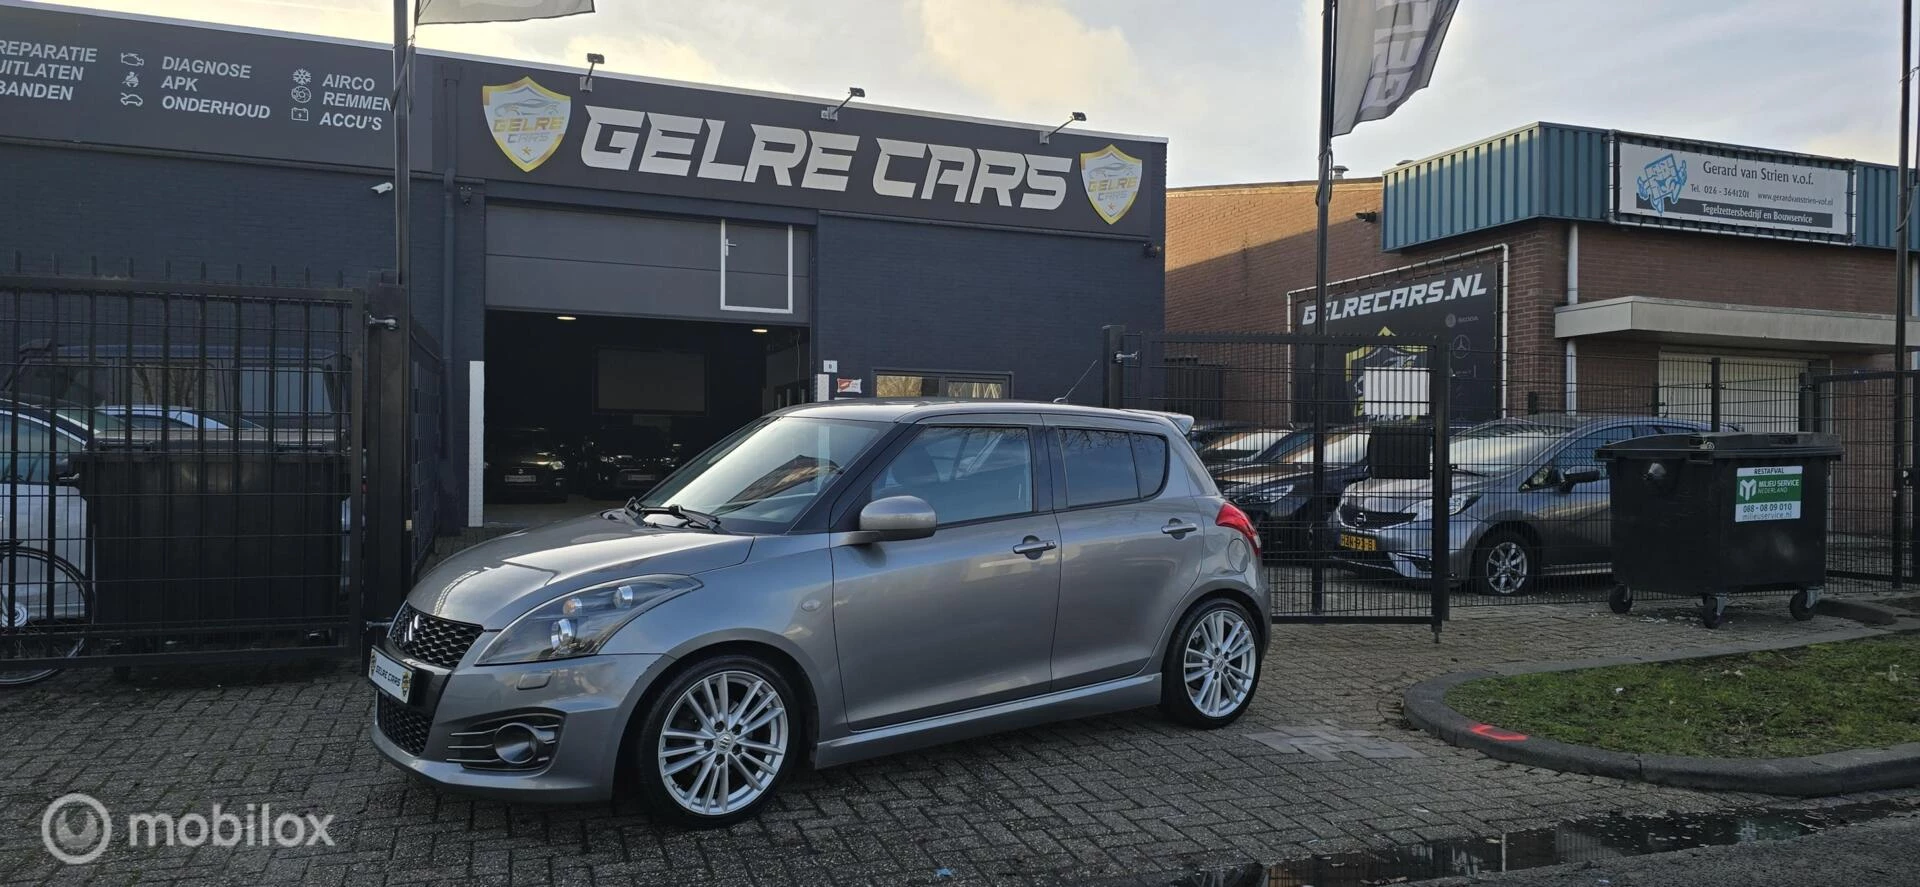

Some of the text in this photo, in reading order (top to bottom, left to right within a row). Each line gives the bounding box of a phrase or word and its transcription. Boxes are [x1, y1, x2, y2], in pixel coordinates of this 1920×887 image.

[0, 40, 98, 62] REPARATIE
[162, 56, 252, 79] DIAGNOSE
[0, 81, 74, 101] BANDEN
[161, 75, 199, 93] APK
[322, 73, 376, 92] AIRCO
[162, 95, 271, 120] ONDERHOUD
[319, 111, 382, 131] ACCU'S
[493, 116, 565, 133] GELRE
[507, 132, 550, 144] CARS
[580, 104, 1073, 210] GELRE CARS
[1702, 160, 1814, 185] Gerard van Strien v.o.f.
[1088, 176, 1138, 192] GELRE
[1690, 183, 1701, 193] Tel.
[1704, 185, 1717, 195] 026
[1723, 187, 1750, 199] 3641201
[1097, 190, 1129, 201] CARS
[1701, 203, 1813, 224] Tegelzettersbedrijf en Bouwservice
[1777, 479, 1800, 487] SERVICE
[1760, 503, 1769, 512] 08
[1769, 503, 1778, 511] 09
[1779, 502, 1792, 511] 010
[376, 665, 401, 687] GELRE CARS
